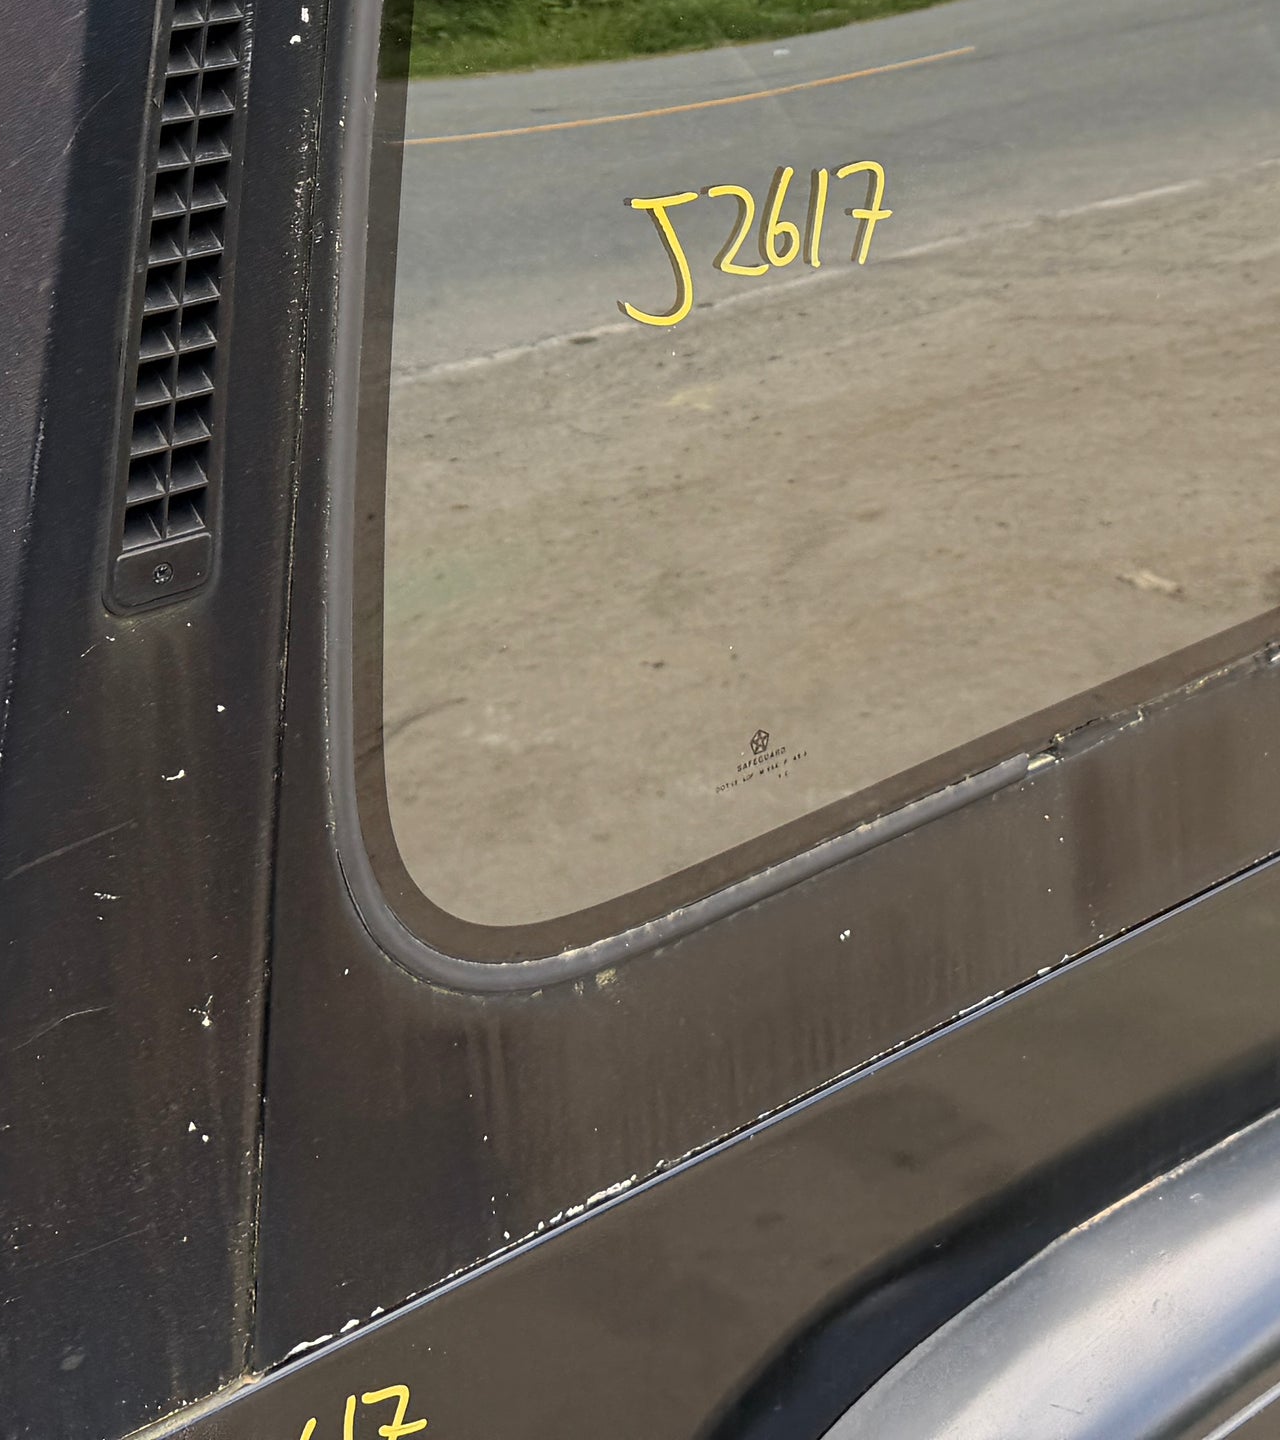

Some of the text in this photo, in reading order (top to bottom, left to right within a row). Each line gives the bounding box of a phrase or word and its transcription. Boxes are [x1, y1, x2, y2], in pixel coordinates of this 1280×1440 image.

[623, 160, 893, 327] J2617
[736, 746, 787, 773] SAFEGUARD
[298, 1383, 428, 1440] 17
